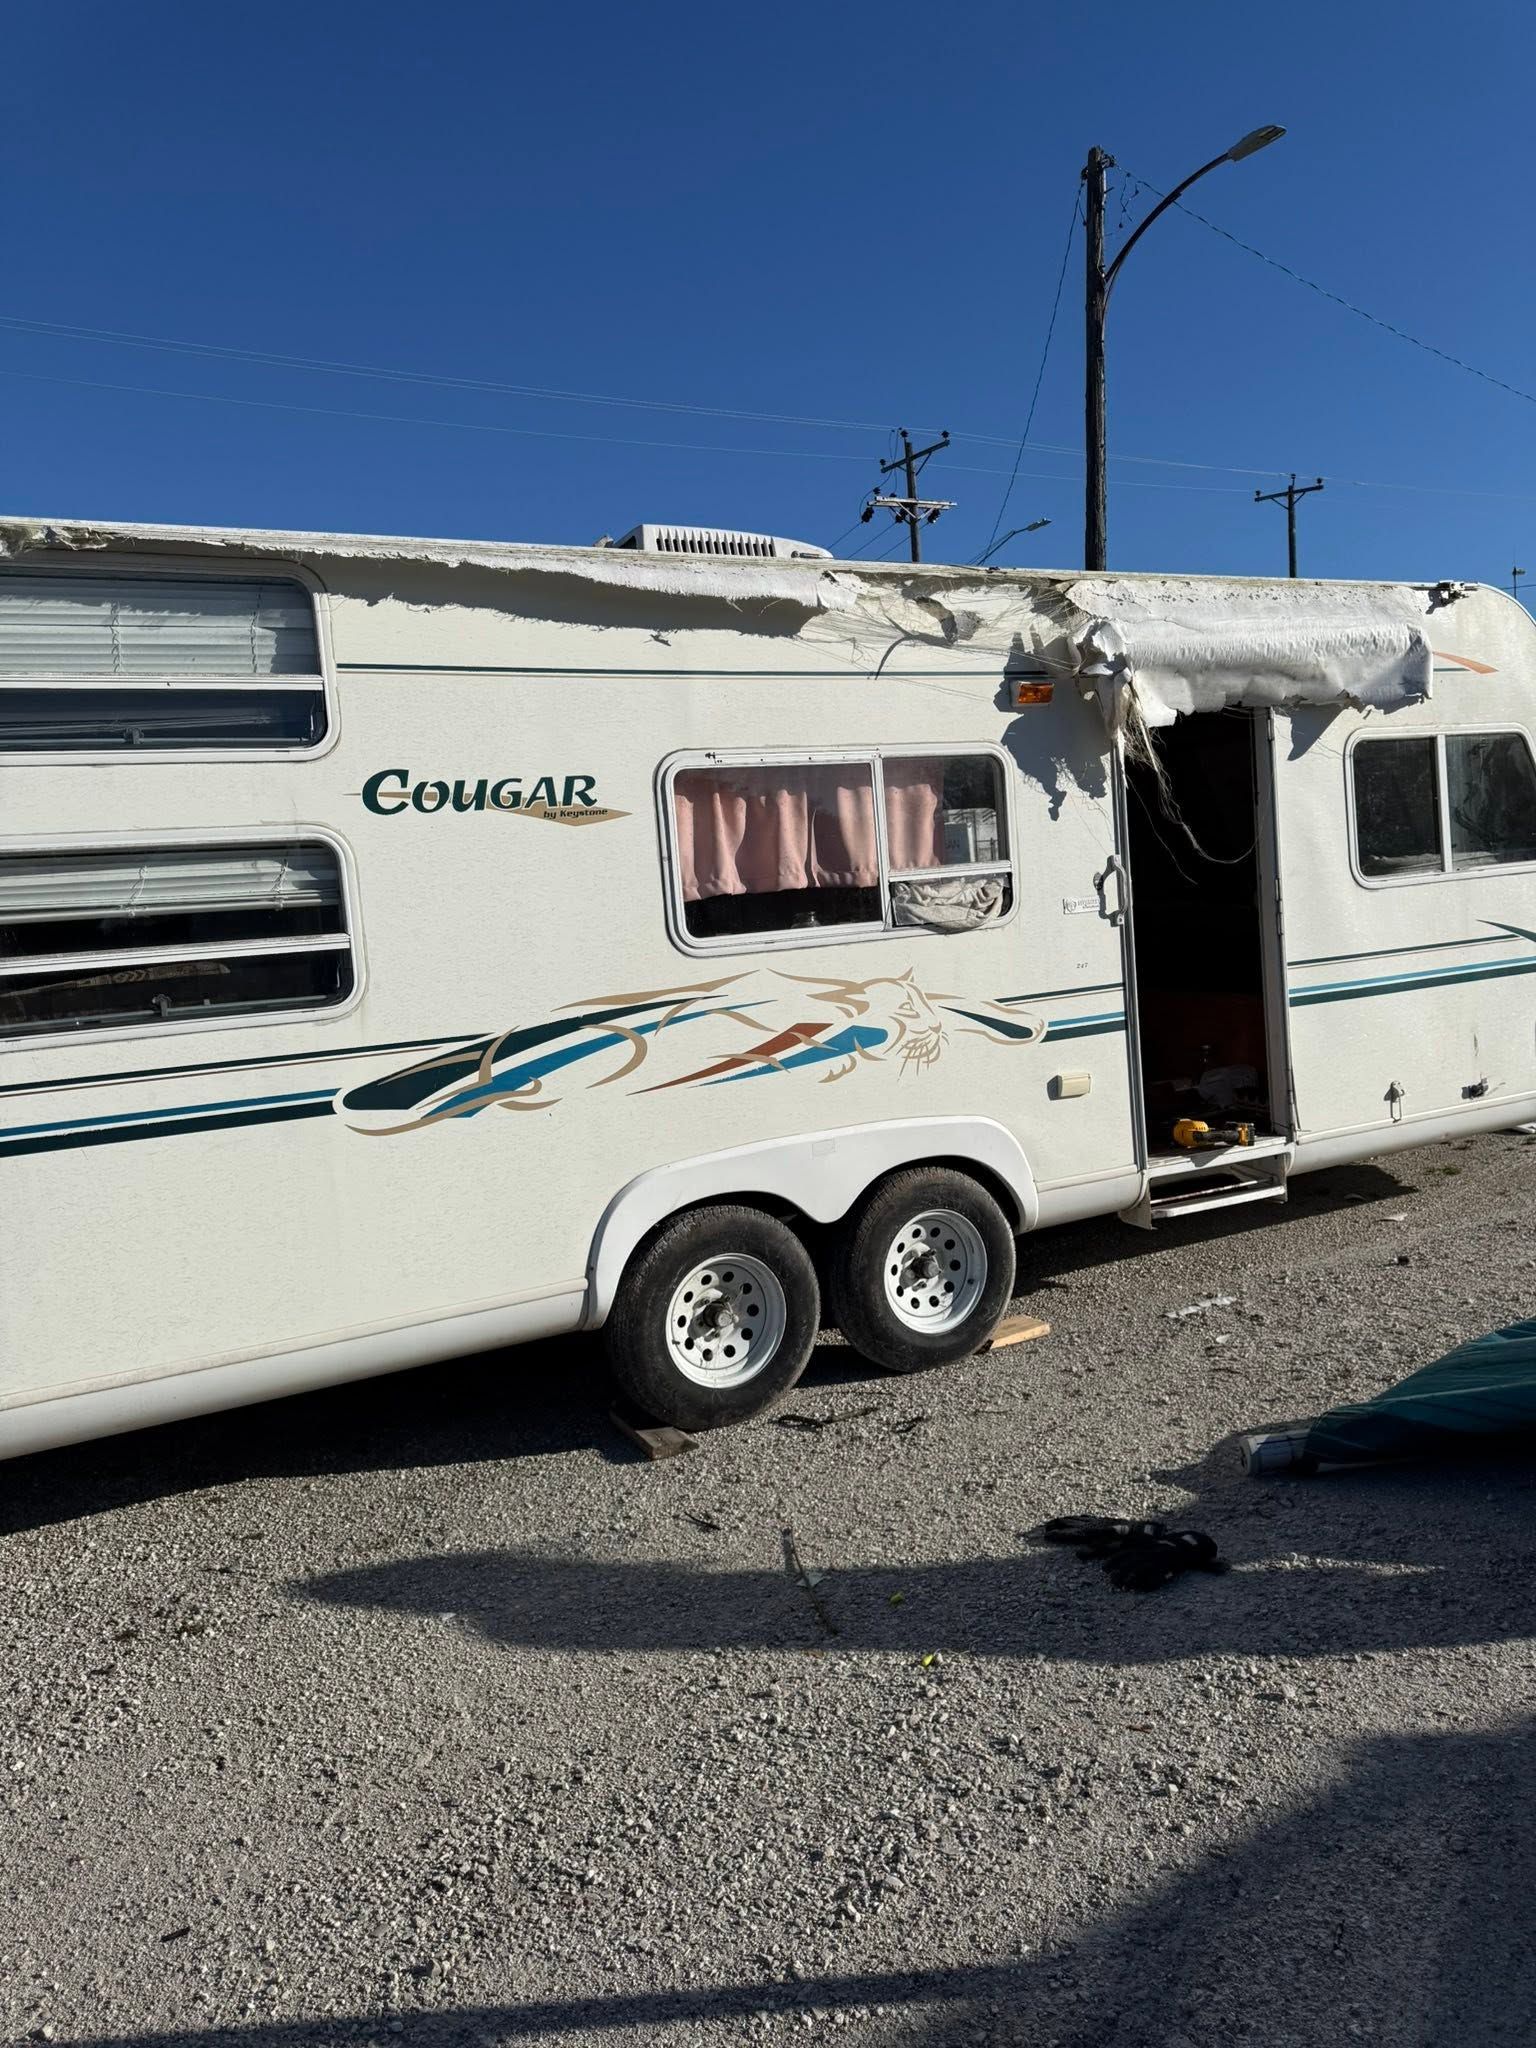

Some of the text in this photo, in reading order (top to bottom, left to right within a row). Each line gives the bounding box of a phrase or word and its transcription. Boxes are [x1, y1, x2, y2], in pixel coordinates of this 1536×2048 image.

[362, 768, 597, 815] COUGAR
[543, 809, 608, 819] by Keystone
